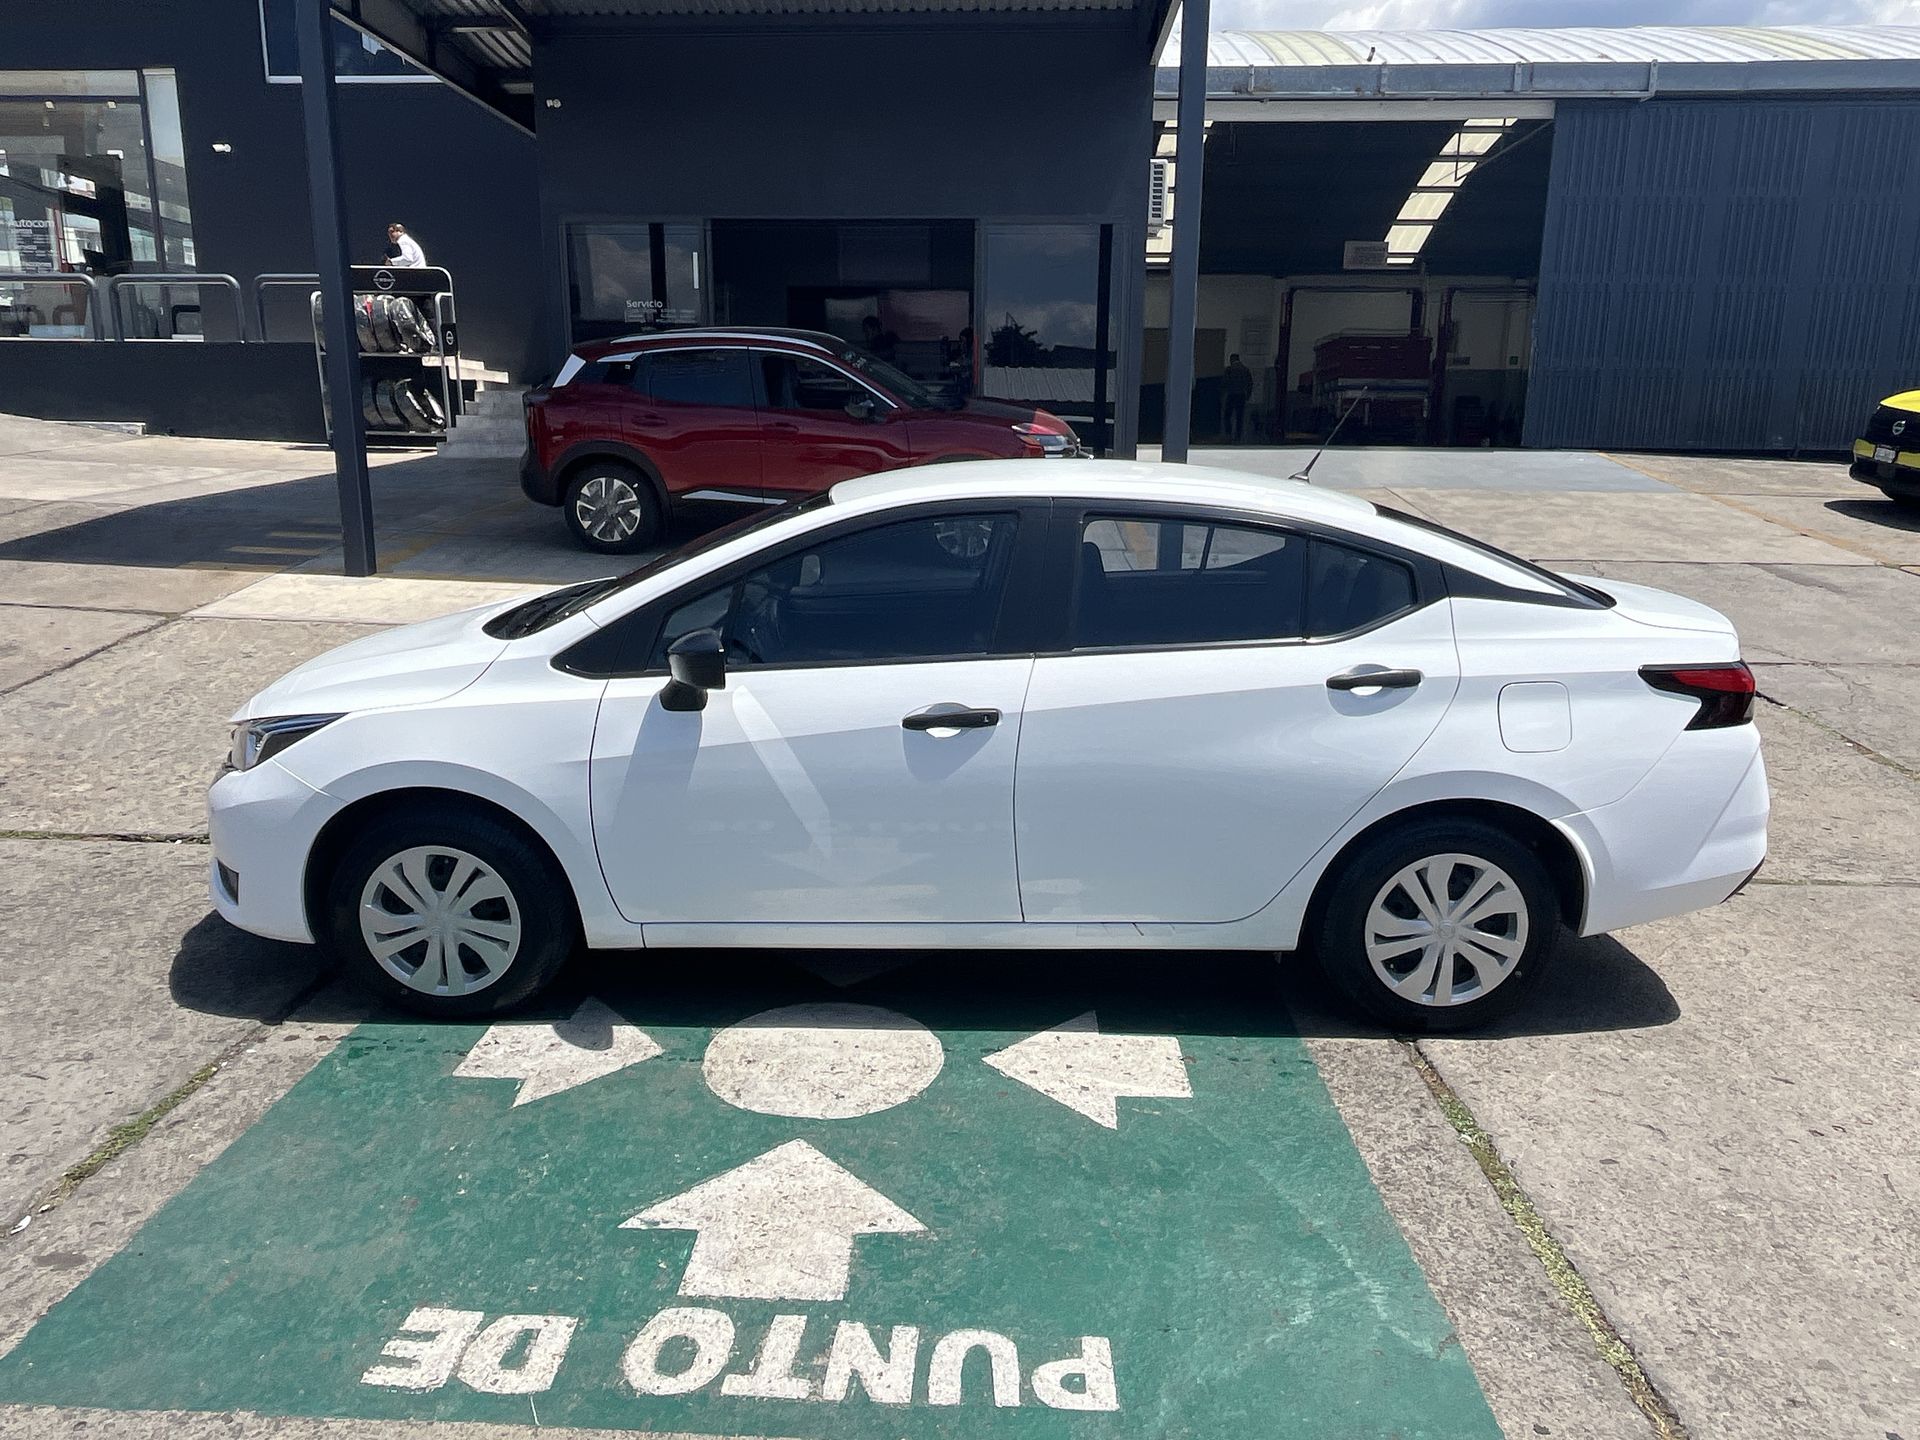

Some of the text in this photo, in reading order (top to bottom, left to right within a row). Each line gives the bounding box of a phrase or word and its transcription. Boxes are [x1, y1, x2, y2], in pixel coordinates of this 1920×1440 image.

[625, 299, 664, 308] Servicio
[360, 1306, 1121, 1412] PUNTO DE
